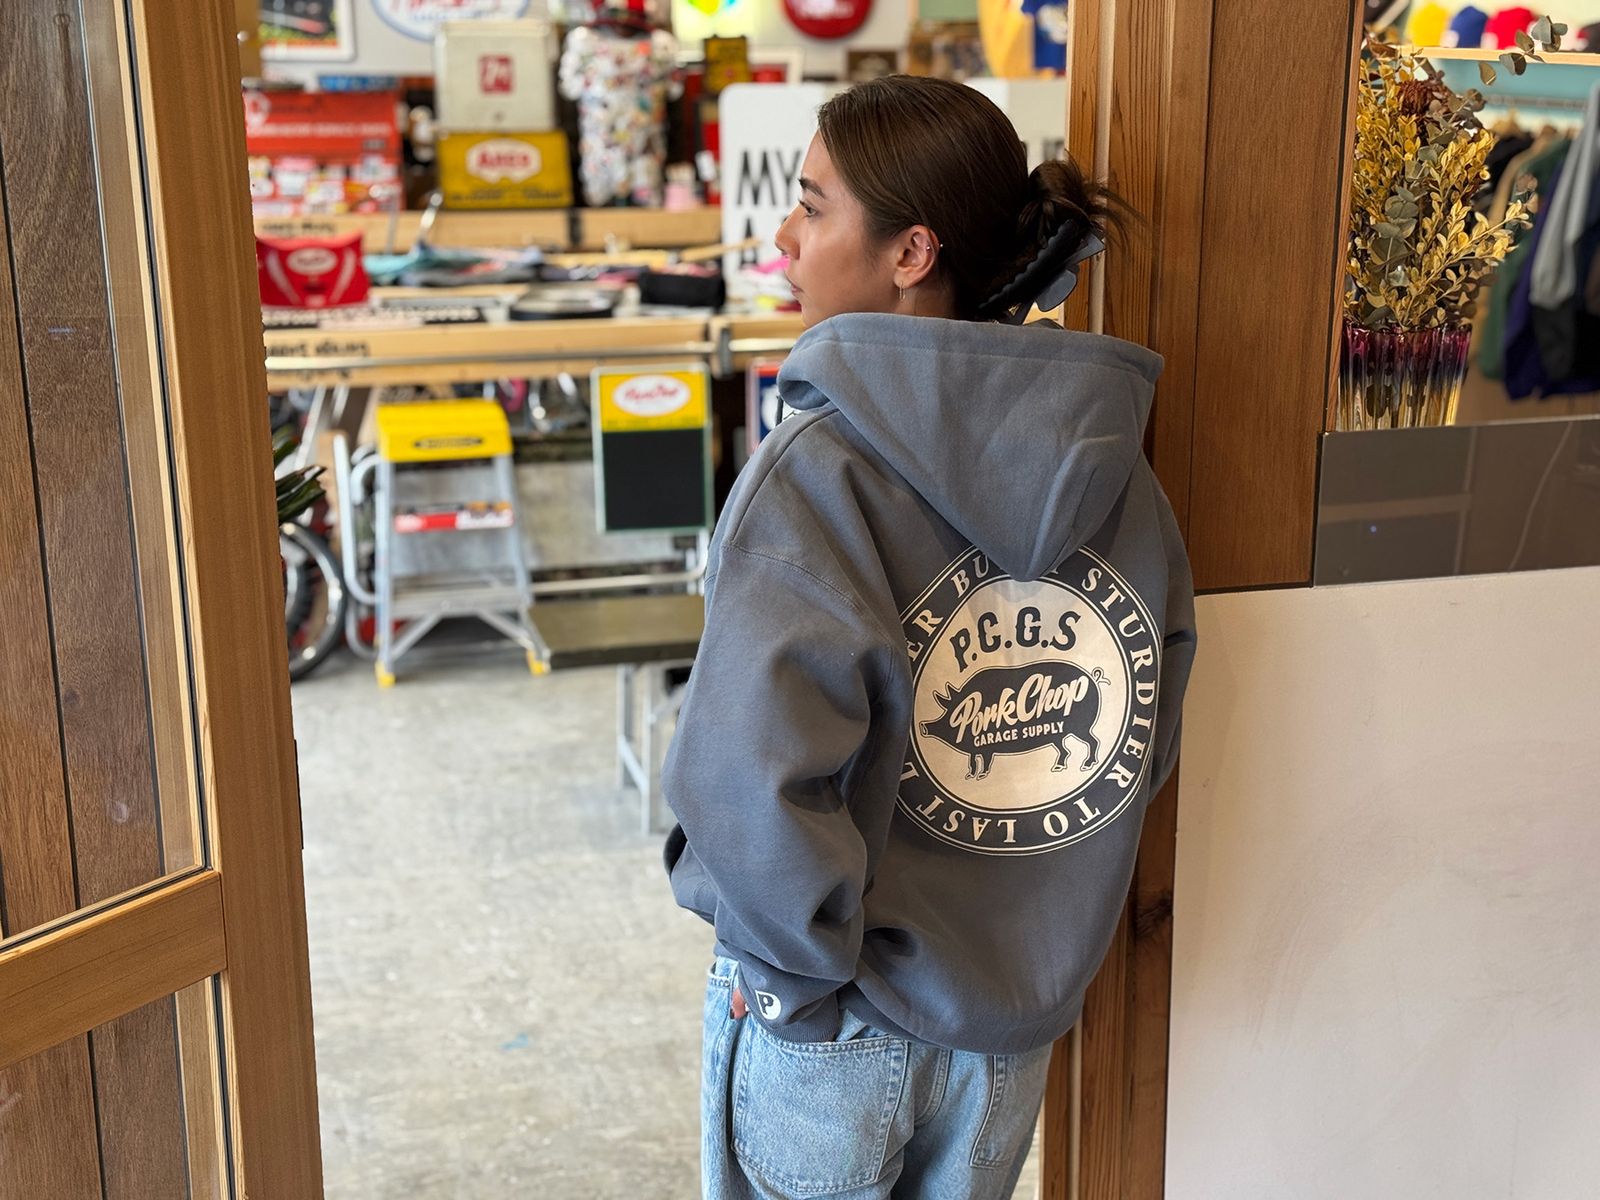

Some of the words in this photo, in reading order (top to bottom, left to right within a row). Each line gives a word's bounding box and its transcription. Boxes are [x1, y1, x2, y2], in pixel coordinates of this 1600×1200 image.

[950, 606, 1082, 673] P.C.G.S
[1082, 567, 1156, 789] STURDIER
[973, 729, 1019, 748] GARAGE
[1022, 721, 1065, 740] SUPPLY
[915, 795, 1017, 843] LAST
[1043, 796, 1101, 837] TO
